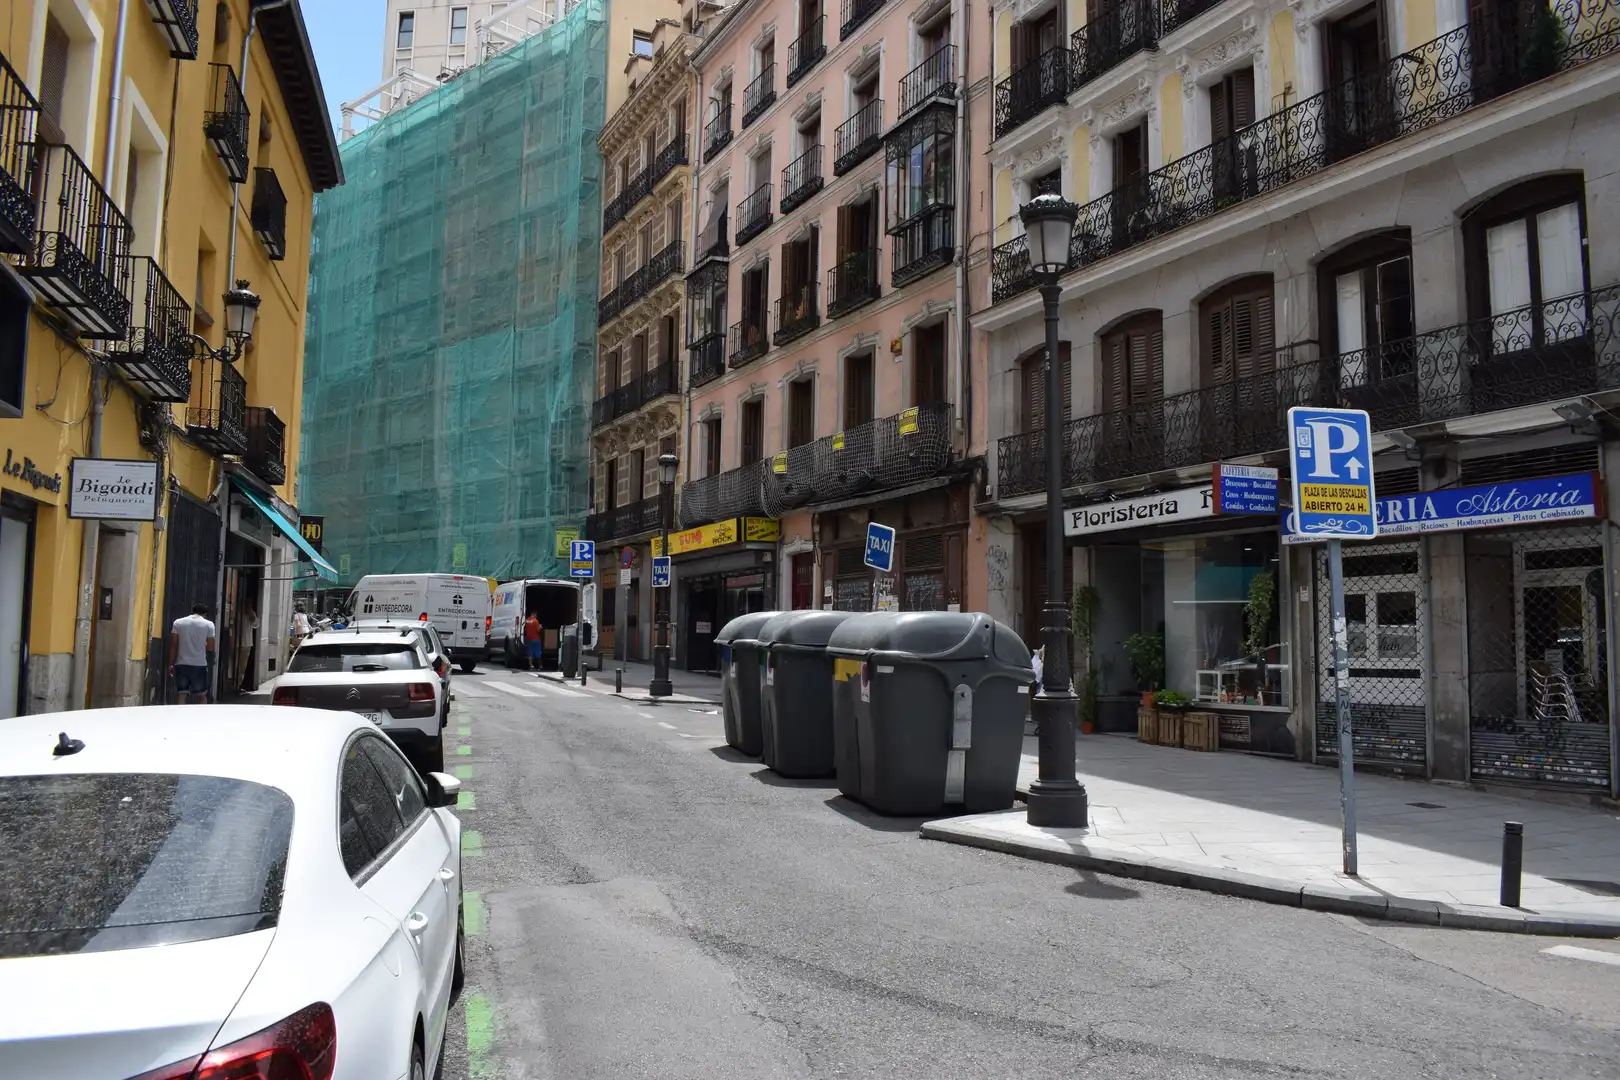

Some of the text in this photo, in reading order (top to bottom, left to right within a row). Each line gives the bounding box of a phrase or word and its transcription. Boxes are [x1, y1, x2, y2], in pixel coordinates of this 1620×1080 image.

[1305, 421, 1360, 478] P
[117, 476, 131, 484] Le
[76, 478, 154, 496] Bigoudi
[1304, 487, 1367, 499] PLAZA DE LAS DESCALZAS
[1456, 482, 1582, 515] Astoria
[1305, 501, 1343, 511] ABIERTO
[1345, 503, 1355, 512] 24
[1072, 498, 1178, 529] Floristería
[712, 535, 732, 544] ROCK
[870, 535, 890, 553] TAXI
[574, 542, 590, 560] P
[654, 566, 669, 574] TAXI
[375, 604, 413, 613] ENTREDECORA
[438, 607, 476, 615] ENTREDECORA
